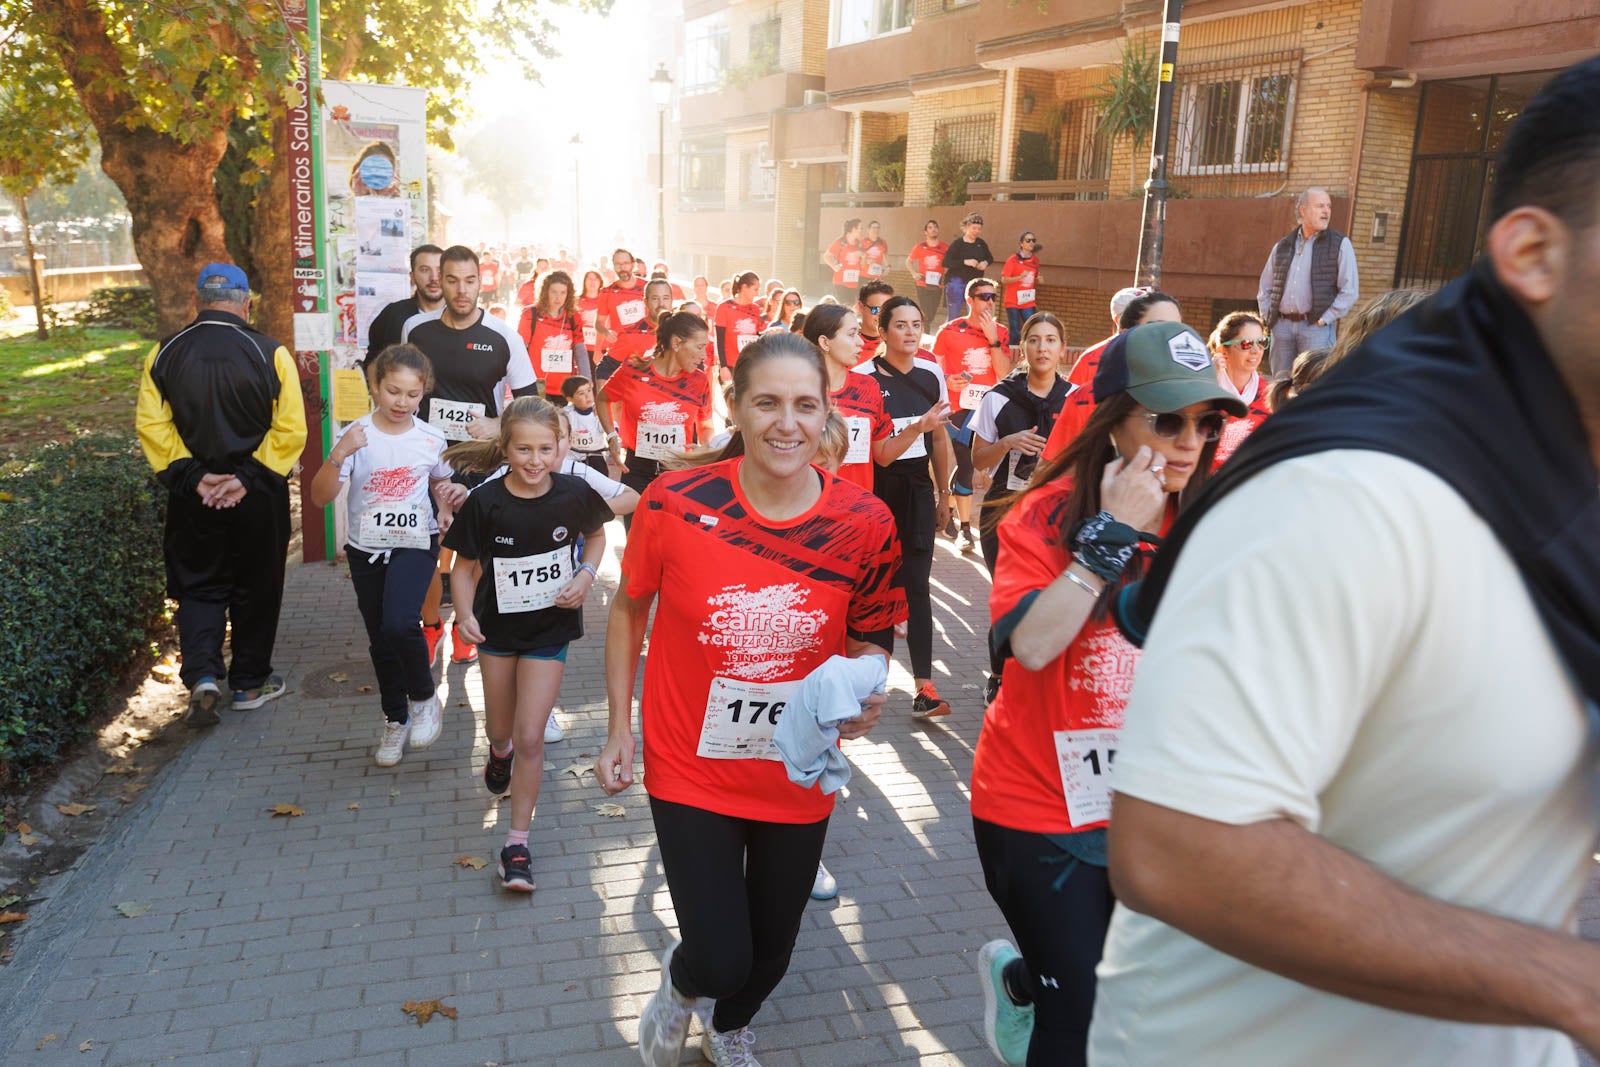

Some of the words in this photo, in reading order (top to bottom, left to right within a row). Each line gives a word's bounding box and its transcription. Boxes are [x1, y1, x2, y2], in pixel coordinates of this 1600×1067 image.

[288, 39, 310, 151] Saluabe
[437, 408, 474, 423] 1428
[645, 432, 676, 444] 1101
[373, 512, 417, 527] 1208
[494, 536, 514, 545] CME
[508, 563, 561, 587] 1758
[711, 611, 817, 634] carrera
[711, 632, 813, 649] cruzroja.es
